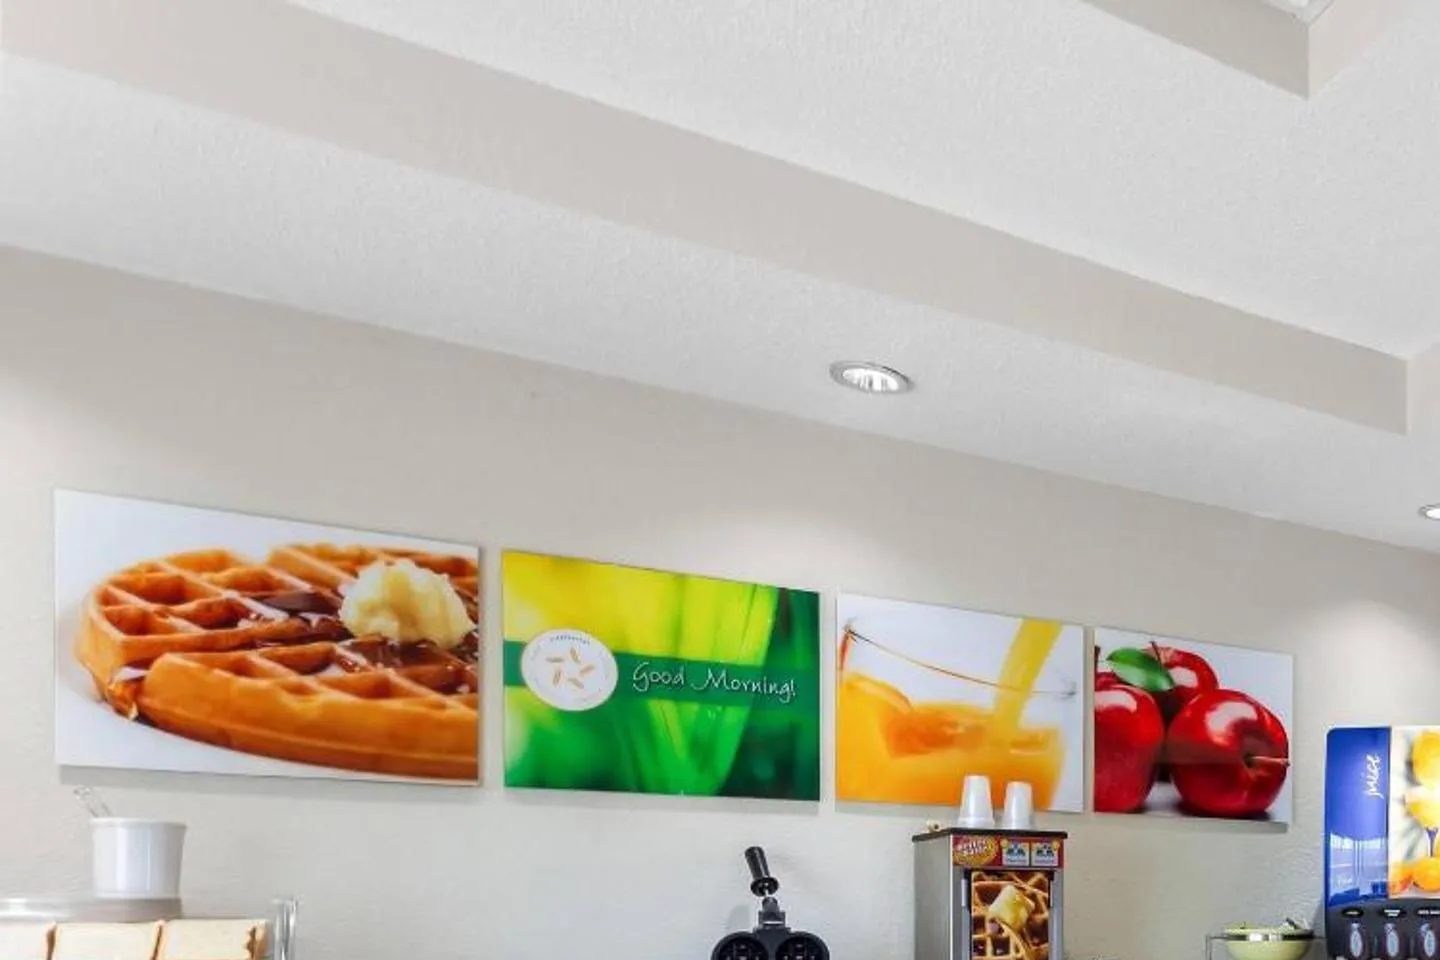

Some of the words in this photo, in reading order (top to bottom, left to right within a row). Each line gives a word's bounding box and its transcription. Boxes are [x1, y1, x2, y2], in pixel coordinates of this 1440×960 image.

[632, 661, 685, 692] Good
[691, 667, 796, 703] Morning!
[1363, 753, 1385, 800] juice
